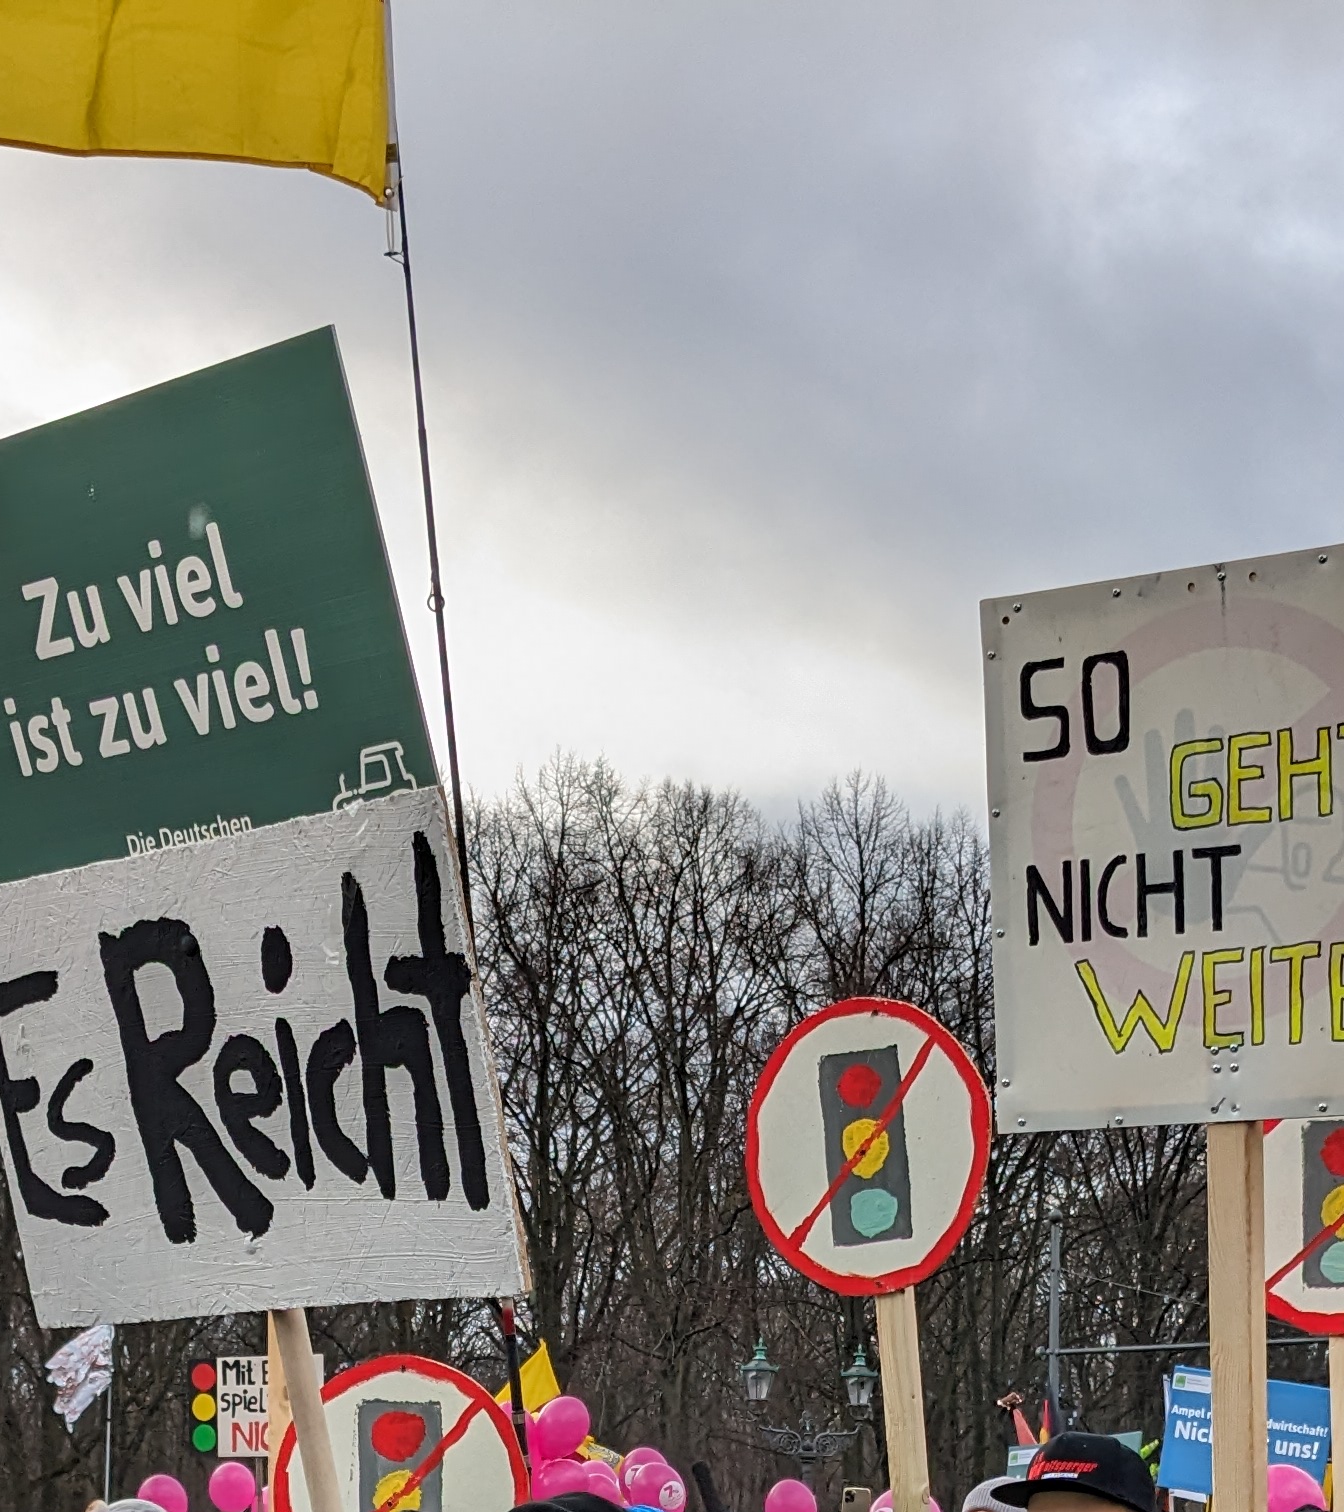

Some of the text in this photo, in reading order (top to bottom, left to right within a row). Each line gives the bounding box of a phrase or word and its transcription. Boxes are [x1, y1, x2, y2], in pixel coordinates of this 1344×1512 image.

[21, 520, 243, 660] Zu viel
[3, 627, 320, 778] ist zu viel!
[1020, 650, 1130, 763] SO
[126, 815, 252, 857] Die Deutschen
[1026, 844, 1242, 946] NICHT
[97, 832, 491, 1244] Reicht
[221, 1359, 256, 1386] Mit
[1171, 1404, 1205, 1419] Ampel
[1267, 1418, 1329, 1438] dwirtschaft!
[231, 1421, 268, 1452] NIC
[1274, 1439, 1320, 1460] uns!
